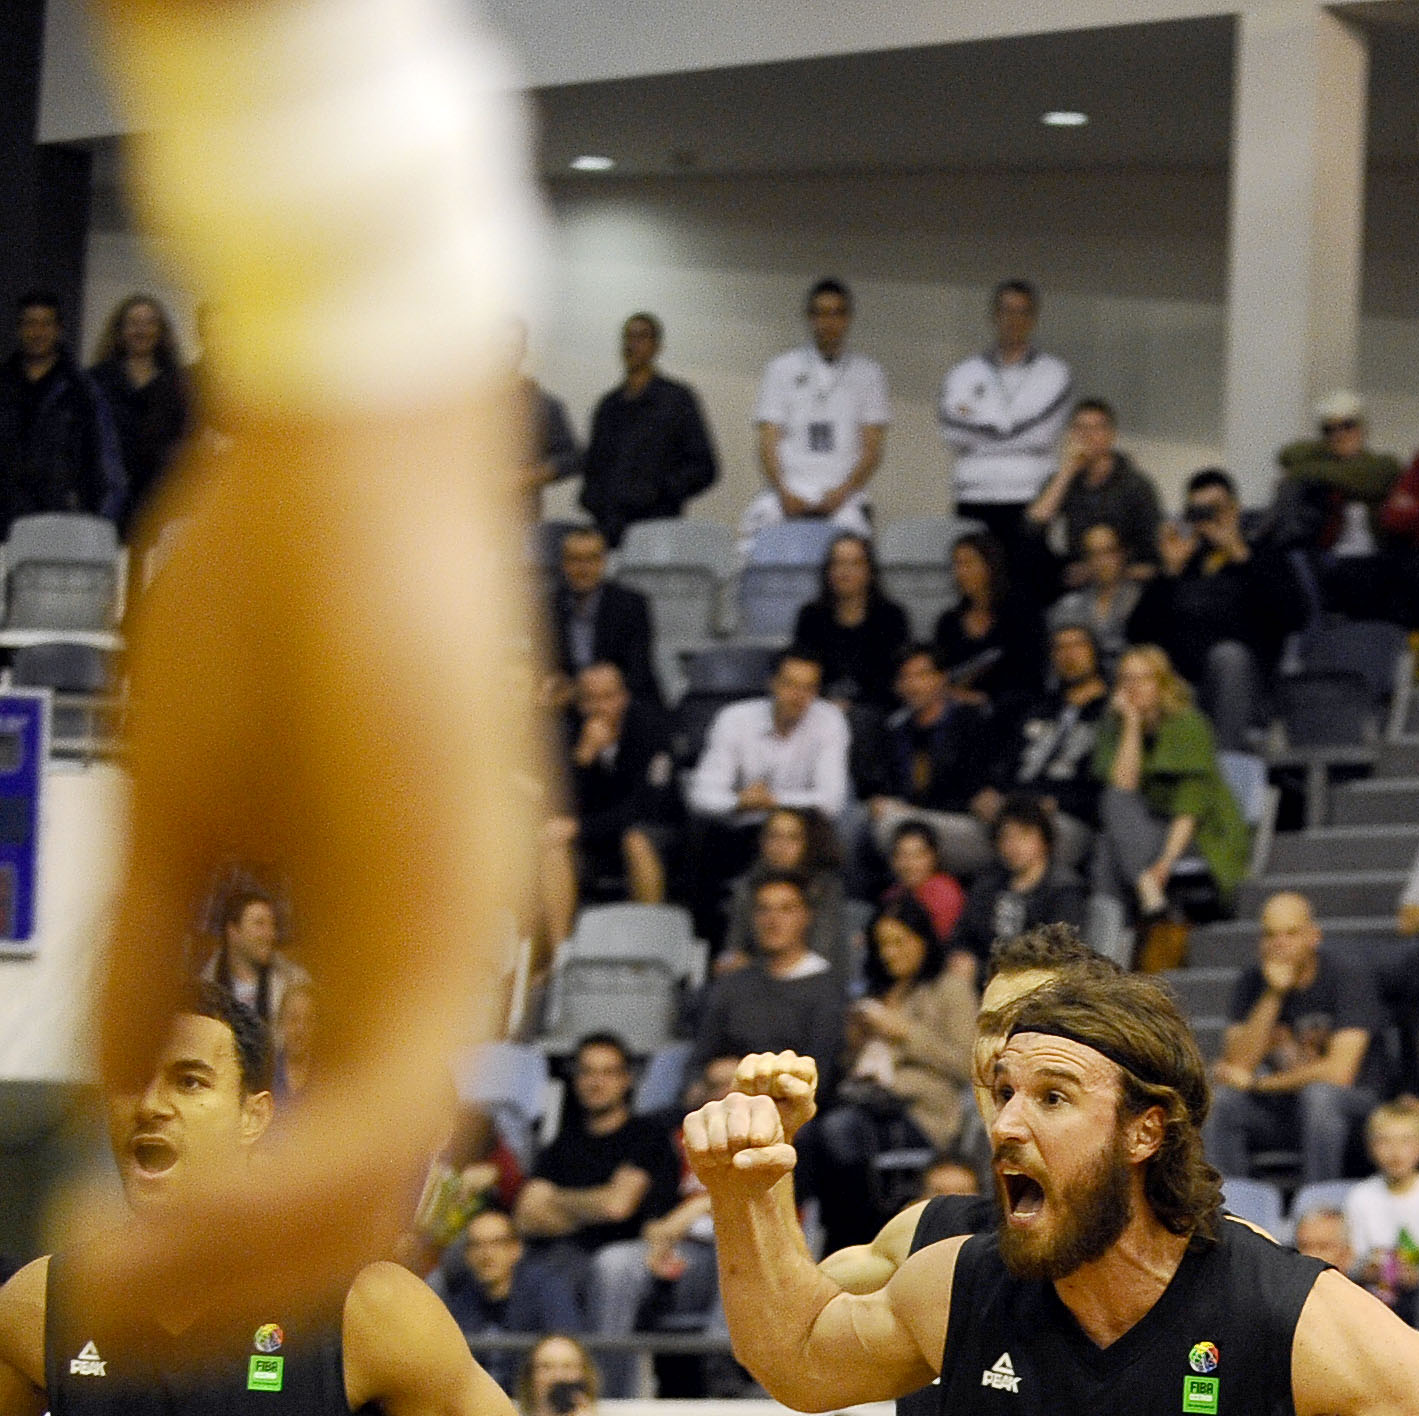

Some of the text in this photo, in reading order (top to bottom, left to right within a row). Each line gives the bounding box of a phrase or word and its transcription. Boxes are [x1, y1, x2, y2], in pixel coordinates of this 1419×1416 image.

[70, 1359, 108, 1377] PEAK
[981, 1369, 1022, 1394] PEAK
[1190, 1381, 1213, 1394] FIBA
